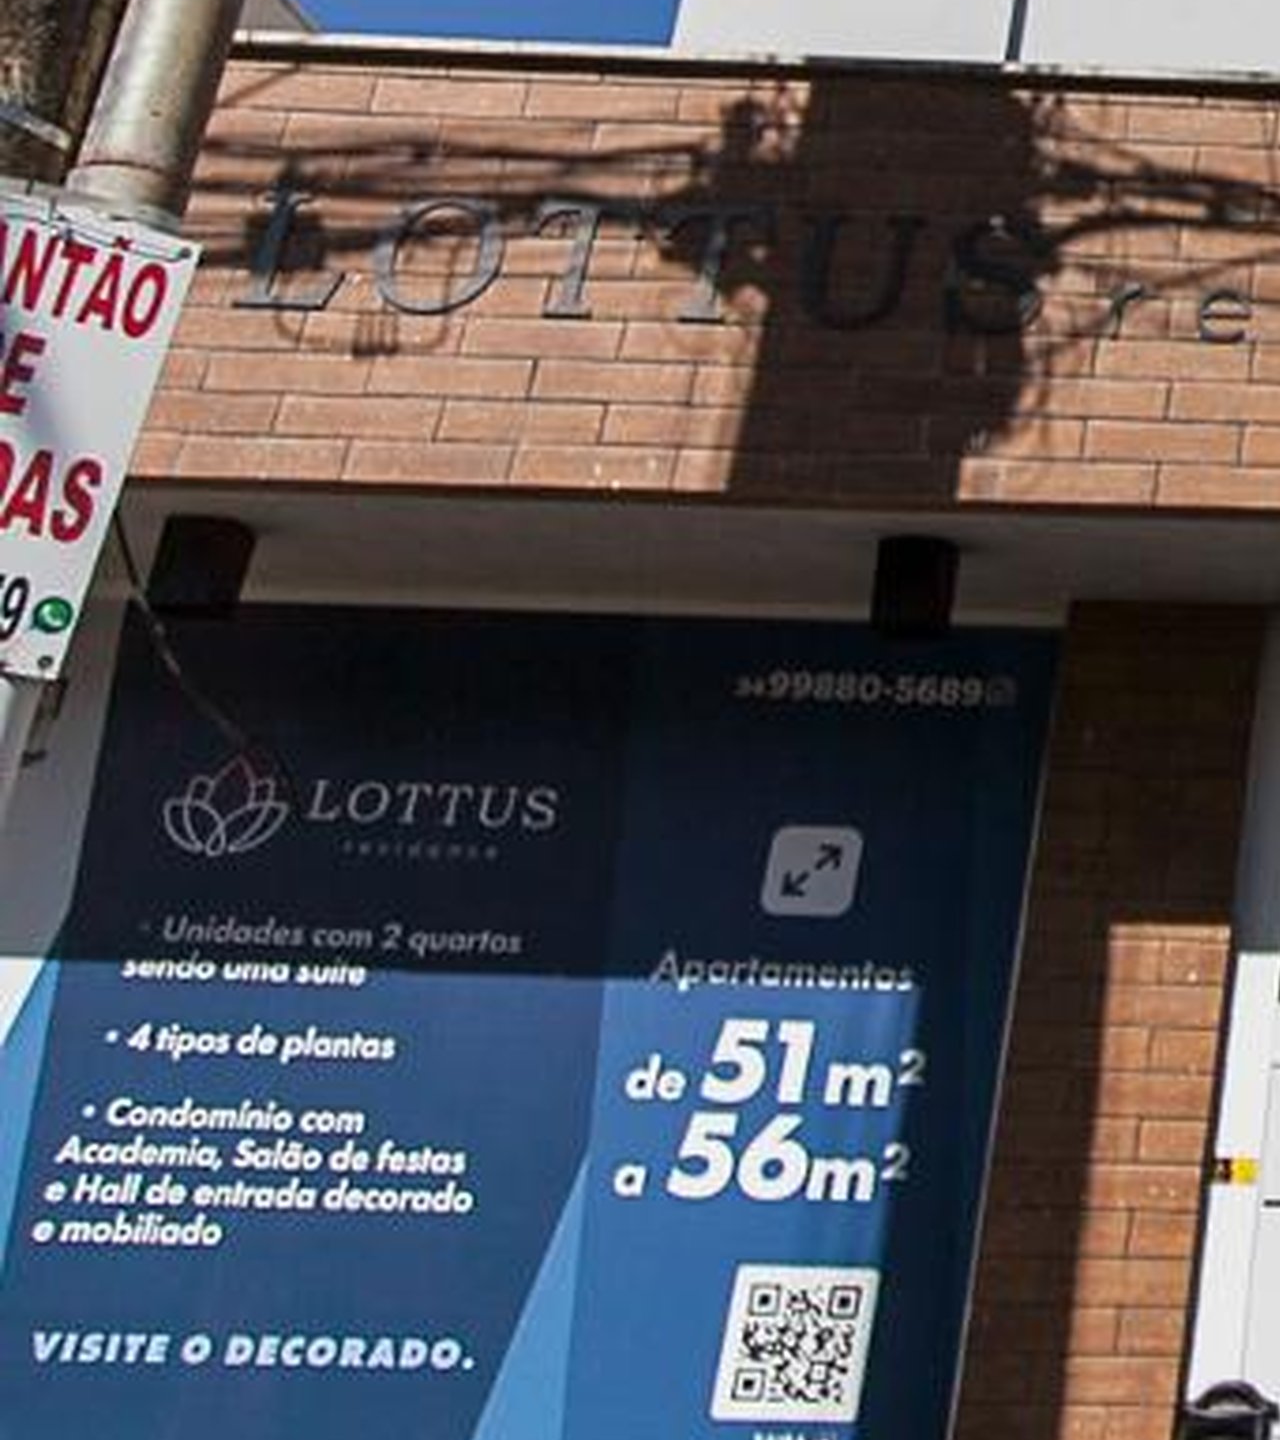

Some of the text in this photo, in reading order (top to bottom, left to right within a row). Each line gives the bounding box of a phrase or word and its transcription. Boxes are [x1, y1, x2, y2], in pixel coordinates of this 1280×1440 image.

[0, 221, 168, 340] NTÃO
[232, 188, 1043, 334] LOTTUS
[305, 778, 559, 830] LOTTUS
[161, 915, 523, 957] Unidades com 2 quartos
[121, 950, 216, 980] sendo
[222, 959, 289, 983] uma
[649, 949, 915, 992] Apartamentos
[128, 1023, 396, 1063] 4 tipos de plantas
[624, 1052, 687, 1102] de
[105, 1097, 366, 1134] Condomínio com
[54, 1135, 468, 1175] Academia, Salão de festas
[43, 1173, 475, 1214] e Hall de entrada decorado
[612, 1164, 648, 1198] a
[31, 1212, 224, 1247] e mobiliado
[31, 1330, 476, 1371] VISITE O DECORADO.
